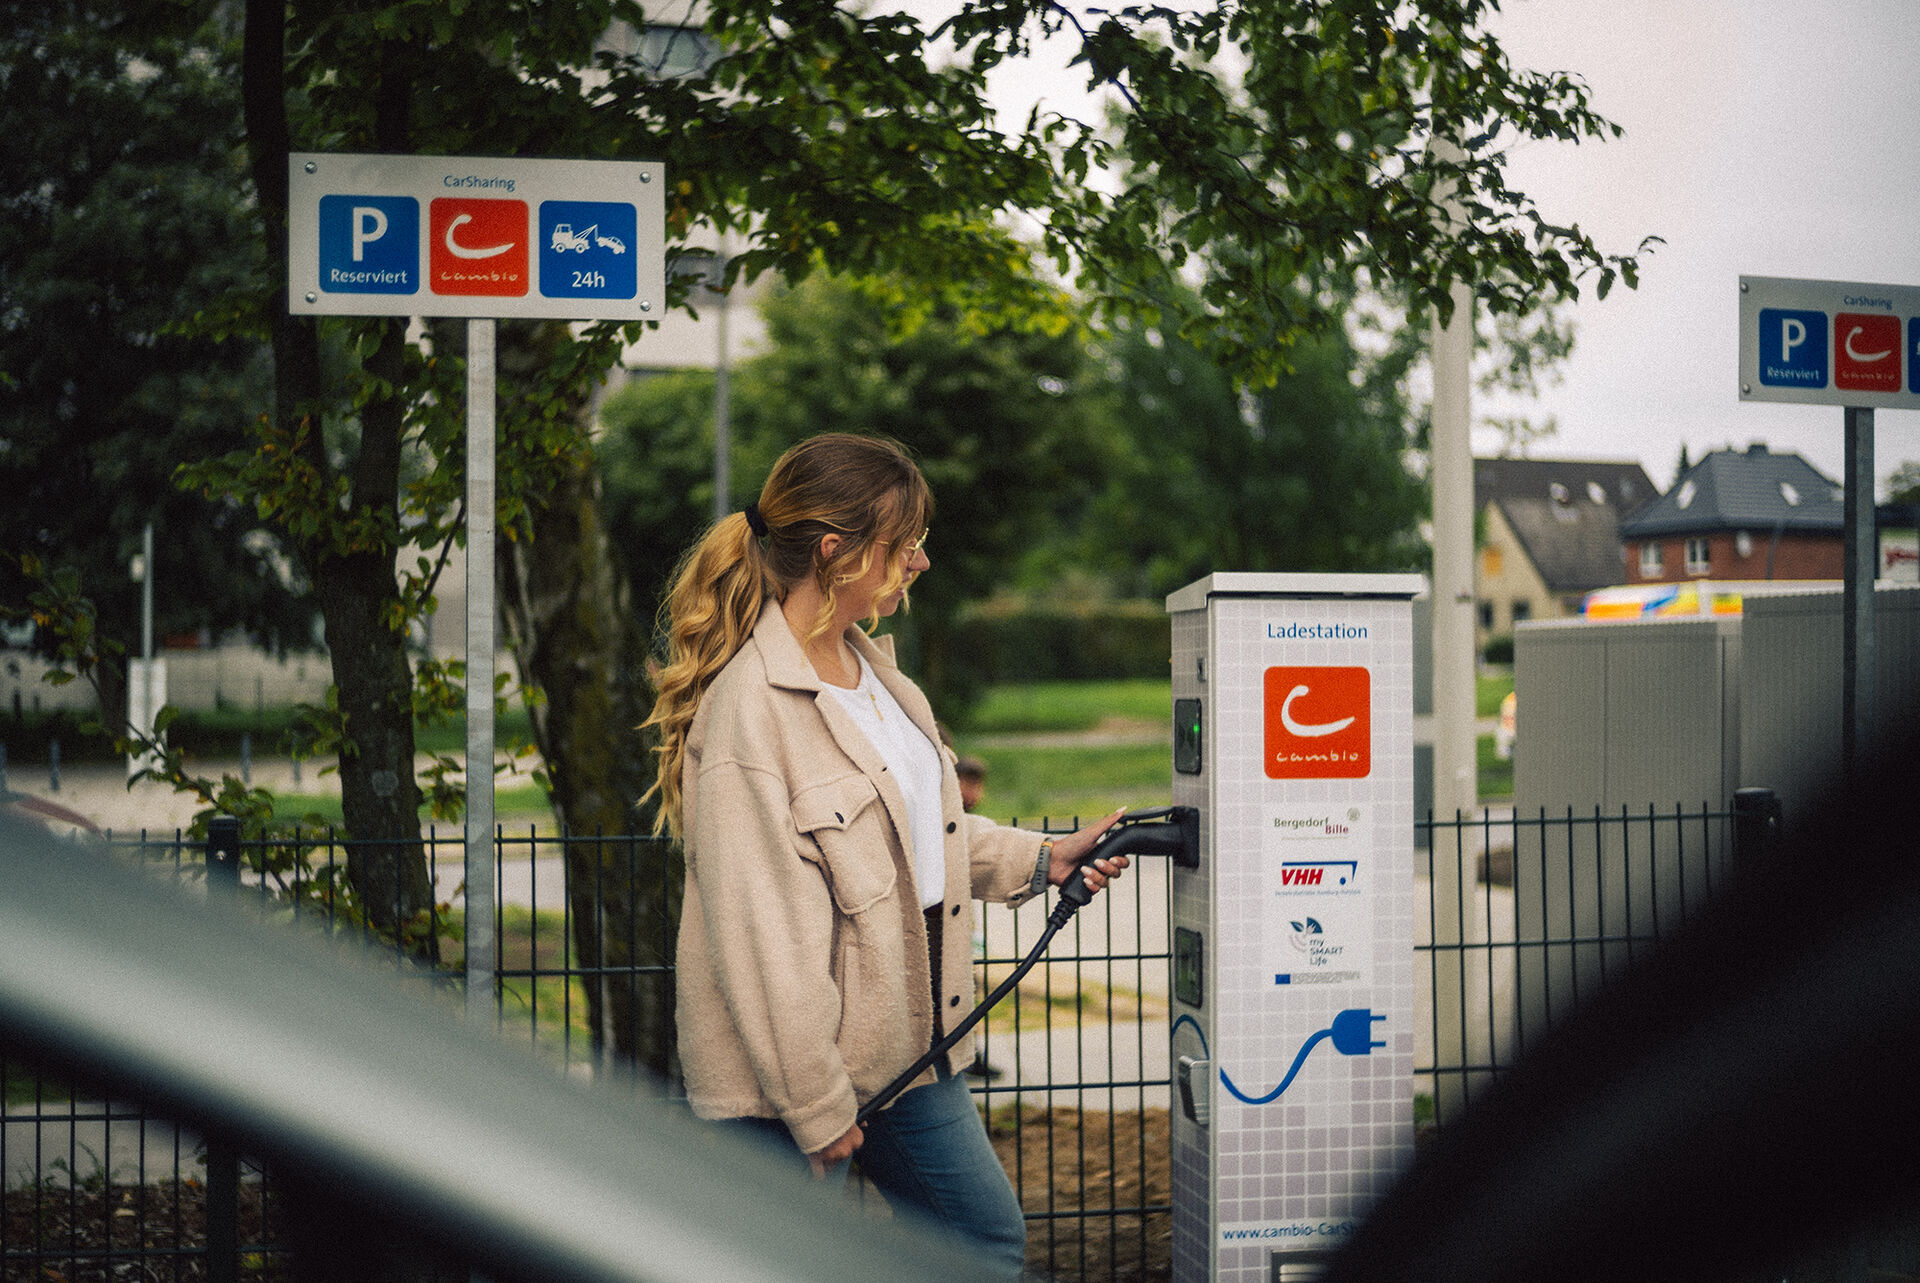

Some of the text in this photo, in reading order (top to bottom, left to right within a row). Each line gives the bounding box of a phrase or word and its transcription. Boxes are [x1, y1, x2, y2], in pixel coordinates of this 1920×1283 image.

[444, 174, 516, 191] CarSharing
[353, 206, 388, 261] P
[330, 268, 408, 285] Reserviert
[441, 270, 519, 283] cambio
[571, 270, 606, 289] 24h
[1844, 295, 1893, 310] CarSharing
[1782, 318, 1807, 363] P
[1767, 366, 1820, 381] Reserviert
[1267, 622, 1368, 638] Ladestation
[1276, 749, 1359, 763] cambio
[1274, 817, 1330, 830] Bergedorf
[1325, 825, 1349, 835] Bille
[1281, 869, 1324, 886] VHH
[1310, 957, 1328, 967] Life
